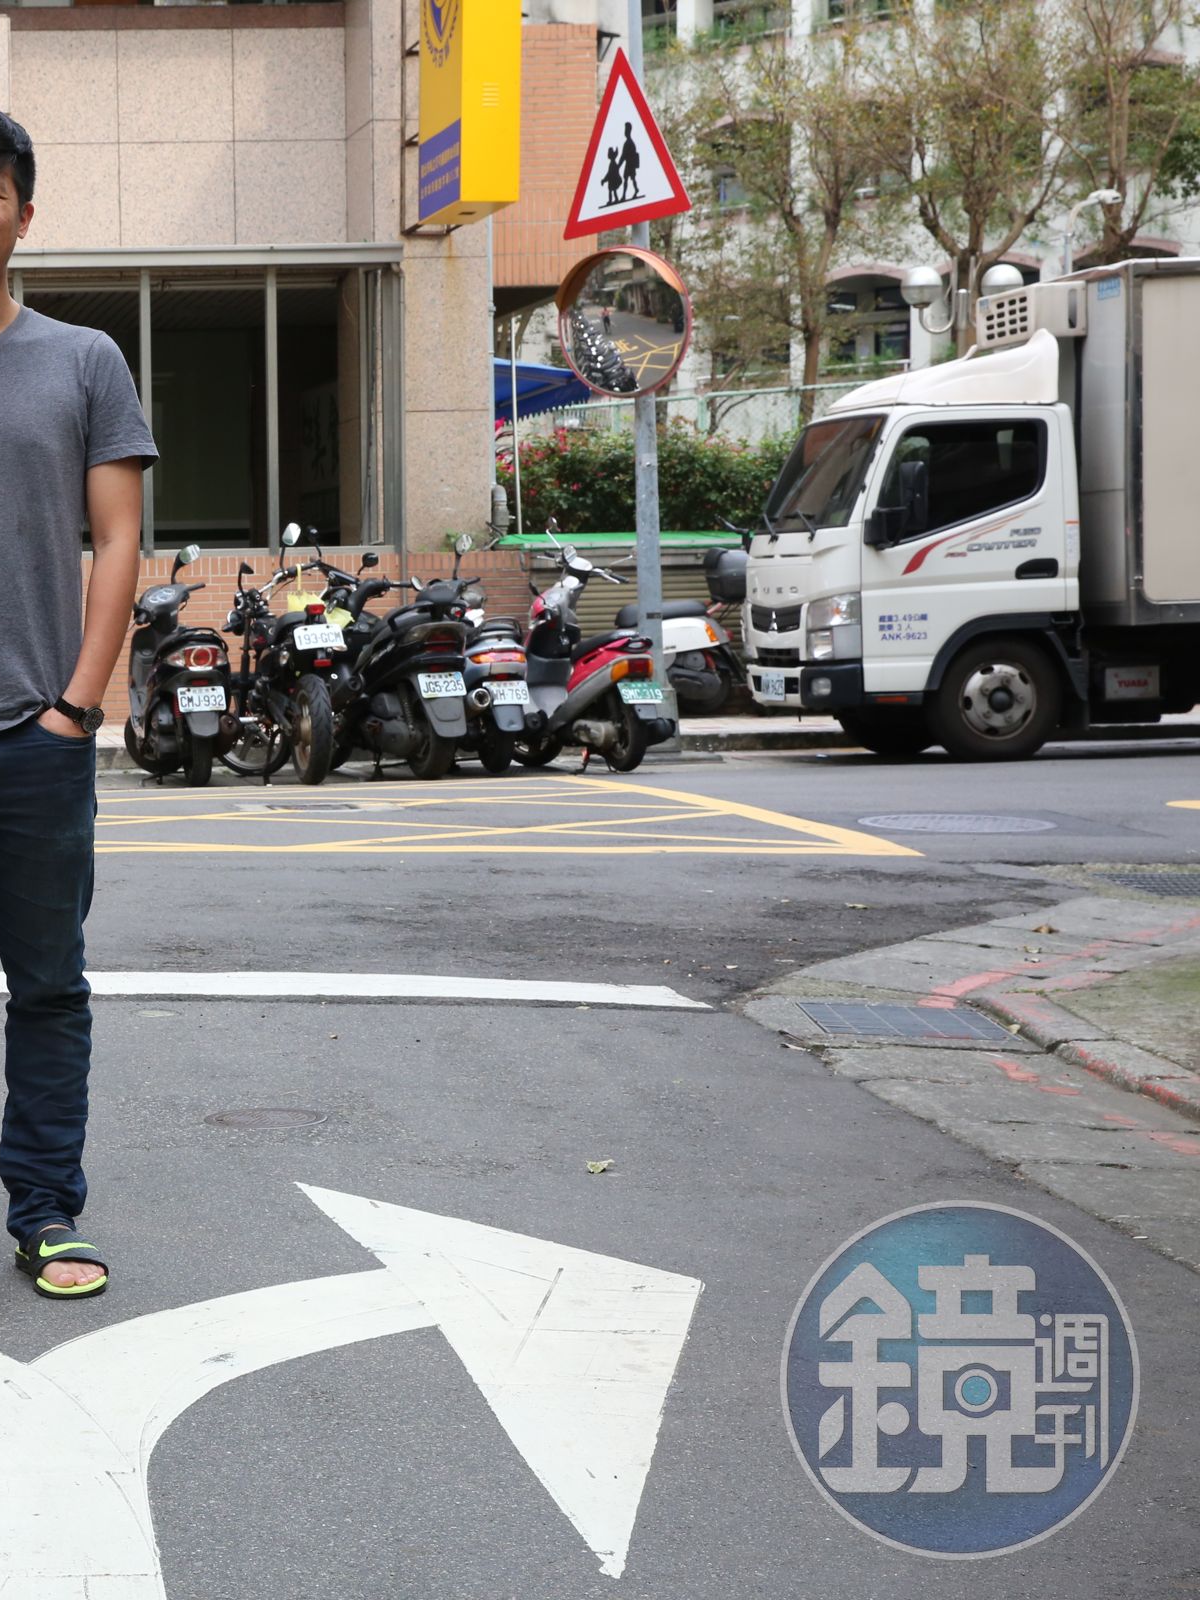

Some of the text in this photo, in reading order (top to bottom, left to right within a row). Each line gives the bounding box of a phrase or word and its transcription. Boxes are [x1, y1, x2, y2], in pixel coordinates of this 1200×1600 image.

[966, 539, 1038, 552] CANTER
[297, 632, 343, 646] 193-GCM
[423, 680, 464, 694] JG5-235
[1117, 679, 1149, 688] YUASA
[179, 695, 225, 707] CMJ-932
